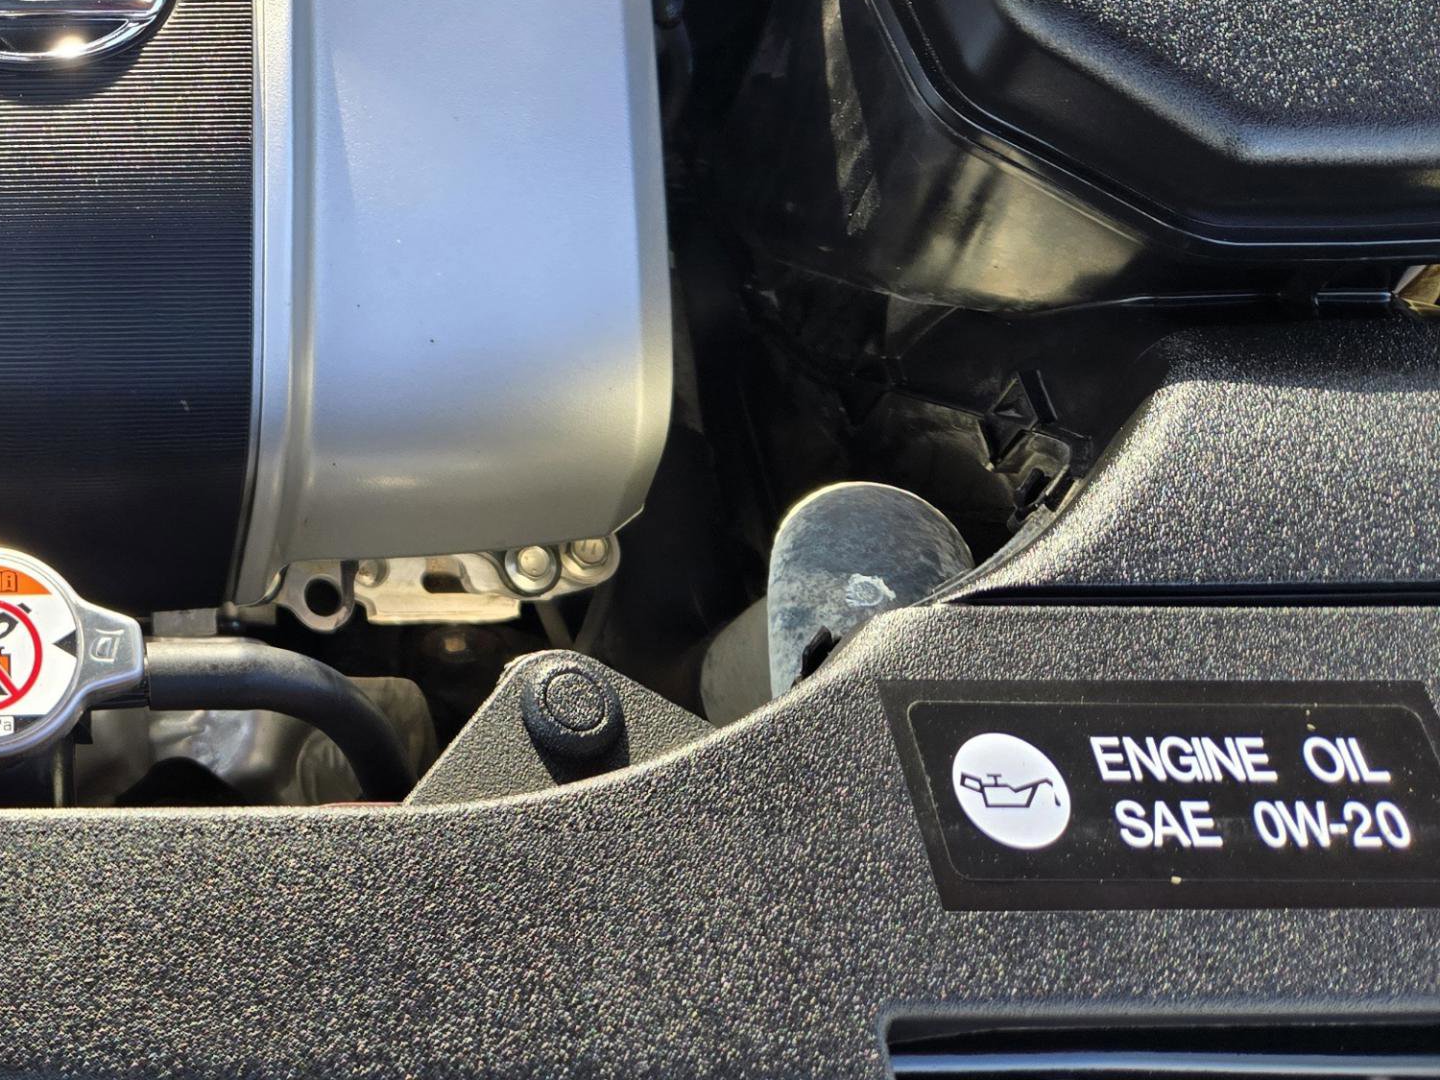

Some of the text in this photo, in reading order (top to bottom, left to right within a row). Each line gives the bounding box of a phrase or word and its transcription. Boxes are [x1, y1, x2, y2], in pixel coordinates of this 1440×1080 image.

[1090, 736, 1391, 783] ENGINE OIL
[1115, 800, 1411, 848] SAE 0W-20
